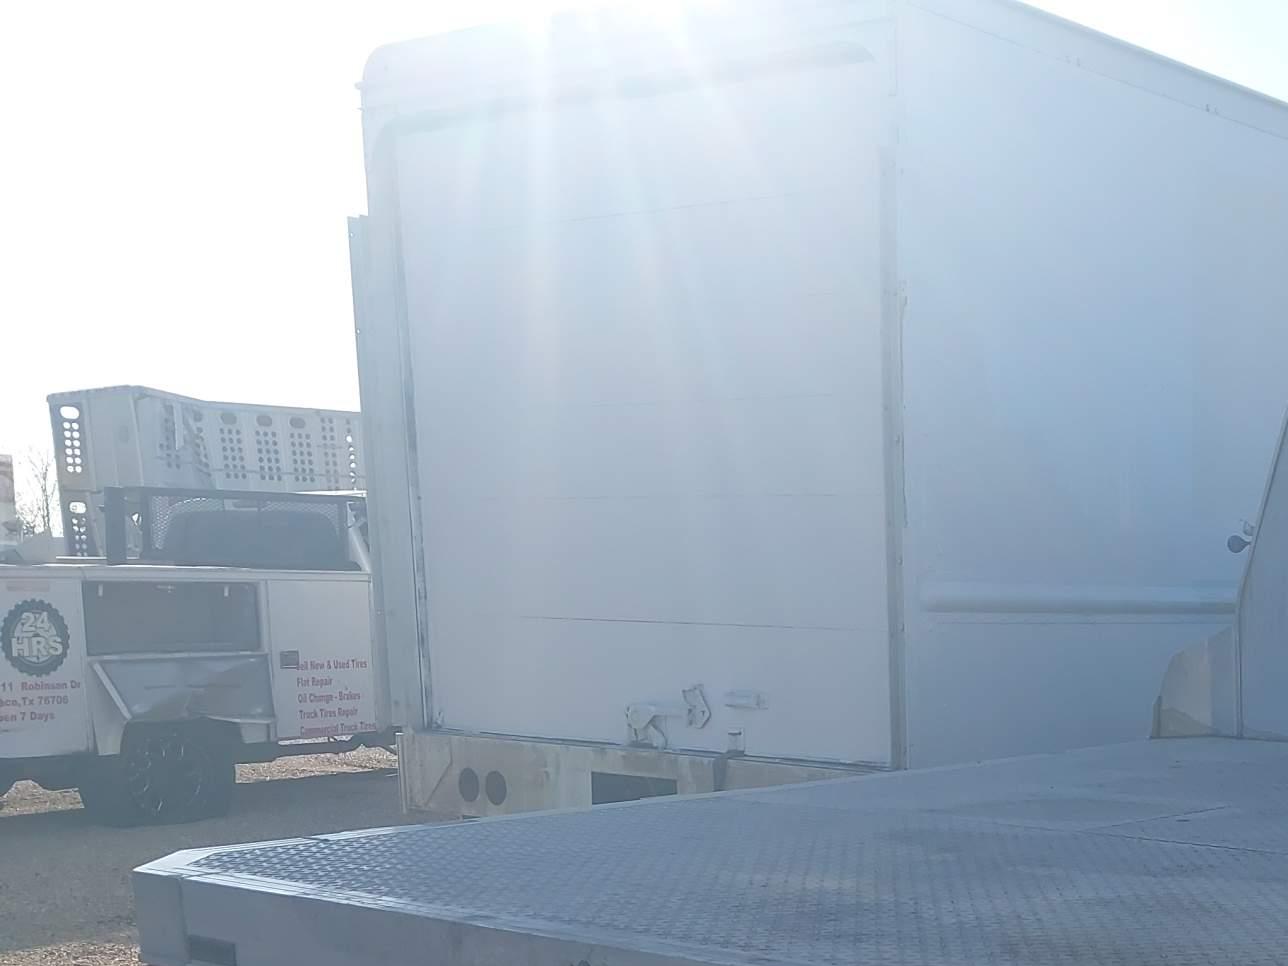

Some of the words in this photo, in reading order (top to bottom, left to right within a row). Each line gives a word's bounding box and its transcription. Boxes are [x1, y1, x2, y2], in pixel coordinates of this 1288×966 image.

[21, 611, 50, 633] 24
[11, 636, 63, 657] HRS
[310, 661, 325, 670] New
[333, 659, 350, 669] Used
[351, 659, 368, 669] Tires
[21, 680, 67, 691] Robinson
[297, 677, 309, 688] Flat
[312, 677, 333, 688] Repair
[297, 693, 307, 703] Oil
[338, 691, 361, 701] Brakes
[20, 711, 26, 721] 7
[30, 711, 56, 723] Days
[299, 709, 318, 720] Truck
[320, 708, 337, 719] Tires
[337, 706, 358, 718] Repair
